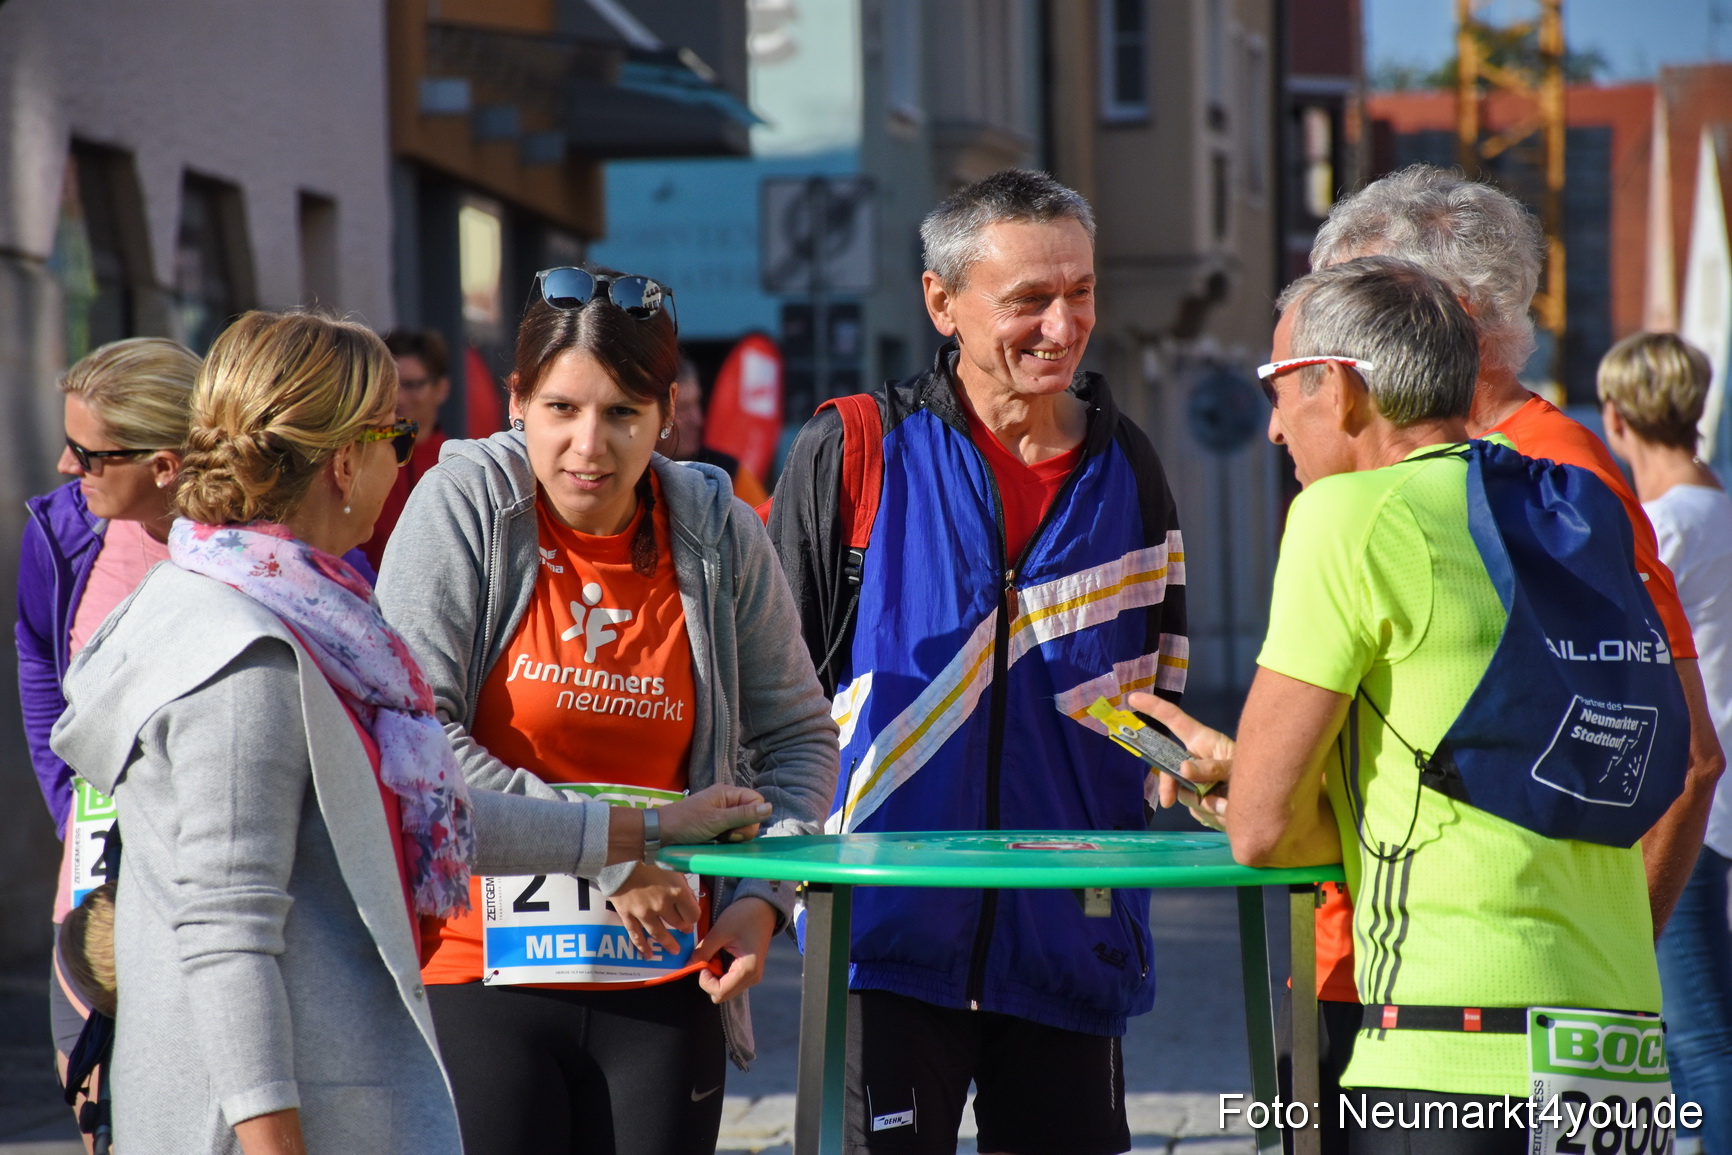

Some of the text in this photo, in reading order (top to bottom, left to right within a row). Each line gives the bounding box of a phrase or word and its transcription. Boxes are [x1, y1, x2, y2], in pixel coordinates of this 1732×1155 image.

[507, 654, 665, 695] funrunners
[556, 690, 684, 721] neumarkt
[1607, 701, 1622, 711] des
[1580, 708, 1639, 731] Neumarkter
[1571, 725, 1627, 751] Stadtlauf
[884, 1117, 902, 1126] DEHN
